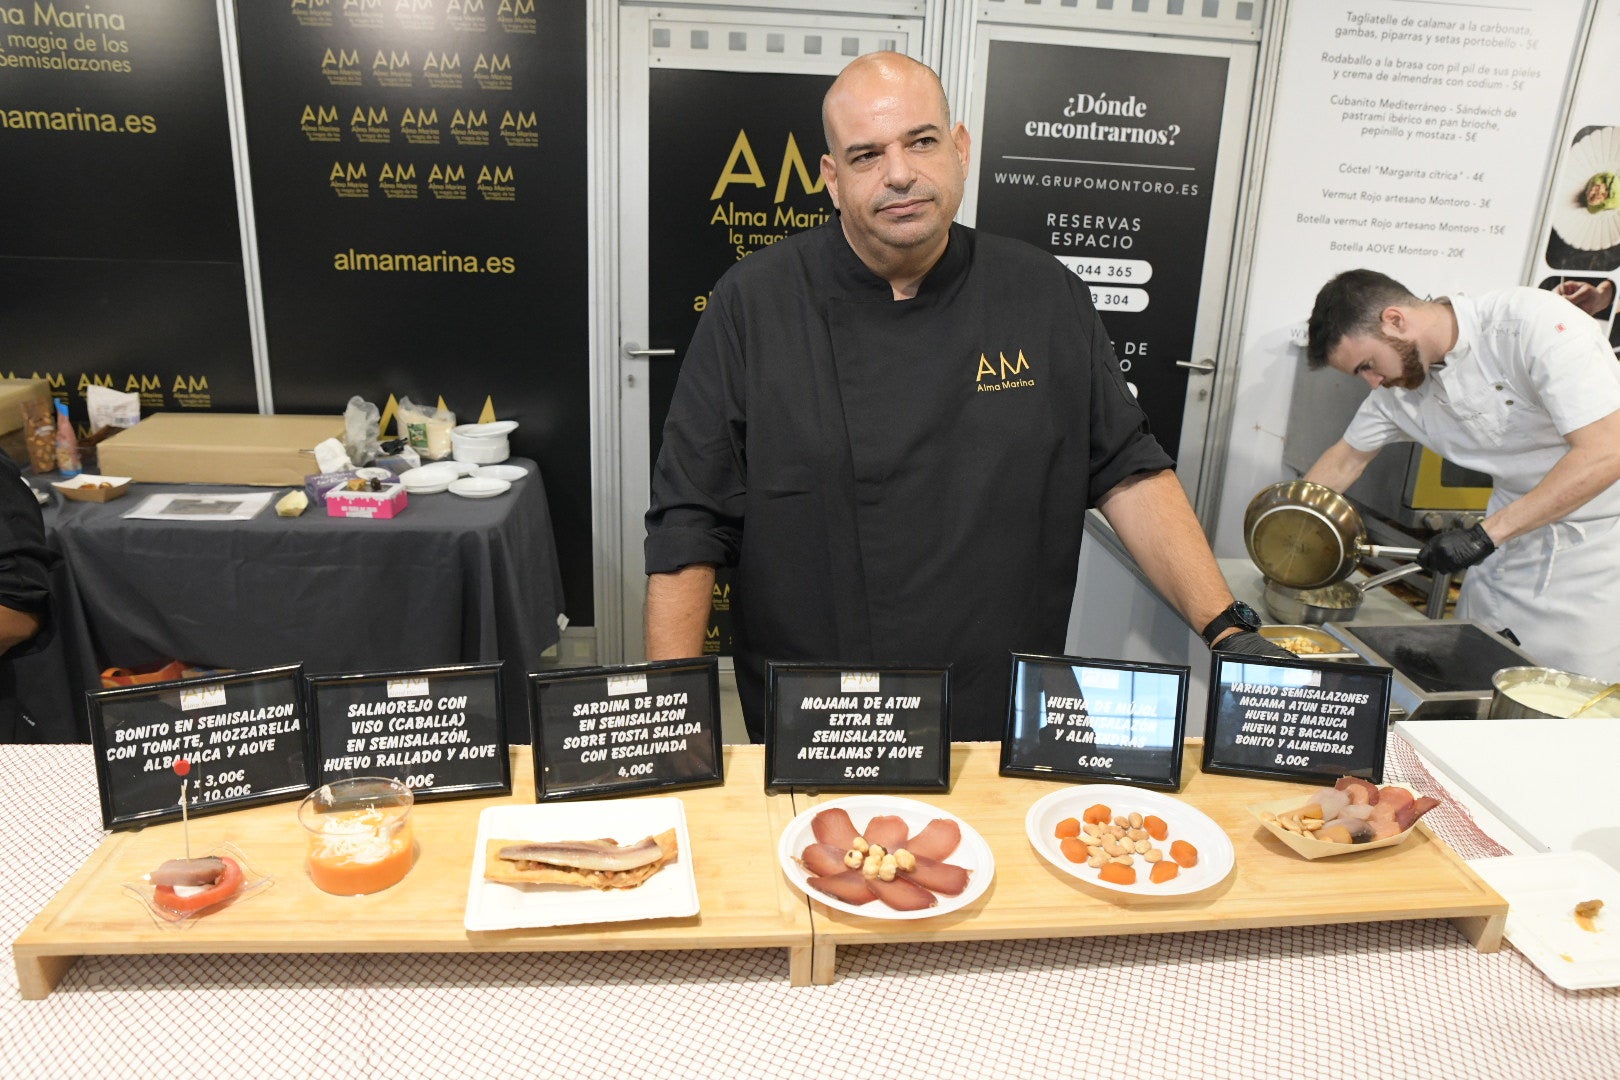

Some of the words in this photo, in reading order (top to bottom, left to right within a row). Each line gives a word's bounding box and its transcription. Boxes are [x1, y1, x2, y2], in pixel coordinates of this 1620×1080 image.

[33, 0, 125, 31] Marina
[1346, 11, 1398, 26] Tagliatelle
[1401, 17, 1415, 27] de
[1417, 18, 1456, 30] calamar
[7, 31, 68, 54] magia
[73, 32, 97, 52] de
[102, 32, 129, 53] los
[1334, 26, 1378, 39] gambas,
[1381, 30, 1423, 42] piparras
[1434, 33, 1461, 45] setas
[1463, 36, 1517, 49] portobello
[0, 48, 132, 73] Semisalazones
[321, 48, 360, 69] AM
[372, 49, 411, 70] AM
[423, 51, 461, 72] AM
[473, 52, 512, 73] AM
[1321, 52, 1372, 67] Rodaballo
[1396, 59, 1424, 71] brasa
[1426, 61, 1445, 72] con
[1446, 62, 1460, 74] pil
[1462, 63, 1476, 76] pil
[1478, 63, 1490, 75] de
[1493, 67, 1510, 77] sus
[1511, 67, 1542, 80] pieles
[1342, 69, 1373, 82] crema
[1376, 71, 1389, 82] de
[1392, 72, 1443, 86] almendras
[1445, 77, 1464, 88] con
[1466, 77, 1503, 90] codium
[300, 104, 338, 126] AM
[1063, 92, 1147, 118] ¿Dónde
[1330, 94, 1376, 108] Cubanito
[1379, 99, 1447, 114] Mediterráneo
[1455, 104, 1502, 118] Sándwich
[1504, 108, 1518, 118] de
[351, 106, 389, 127] AM
[400, 106, 439, 128] AM
[450, 108, 488, 129] AM
[499, 109, 537, 131] AM
[1341, 110, 1386, 123] pastrami
[1388, 112, 1423, 126] ibérico
[1425, 117, 1438, 126] en
[1439, 118, 1459, 129] pan
[1461, 119, 1500, 132] brioche,
[1025, 120, 1181, 146] encontrarnos?
[1361, 126, 1405, 138] pepinillo
[1415, 130, 1456, 142] mostaza
[1465, 131, 1477, 143] 5€
[329, 161, 367, 182] AM
[378, 162, 416, 183] AM
[427, 163, 465, 184] AM
[477, 164, 514, 184] AM
[1338, 162, 1371, 175] Cóctel
[1472, 172, 1485, 183] 4€
[994, 172, 1199, 196] WWW.GRUPOMONTORO.ES
[1322, 188, 1358, 201] Vermut
[1360, 191, 1382, 203] Rojo
[1384, 194, 1427, 205] artesano
[1428, 196, 1471, 208] Montoro
[1477, 199, 1492, 209] 3€
[710, 202, 767, 226] Alma
[1046, 213, 1142, 232] RESERVAS
[1296, 213, 1331, 225] Botella
[1333, 217, 1368, 227] vermut
[1370, 217, 1393, 230] Rojo
[1395, 220, 1436, 231] artesano
[1438, 222, 1480, 234] Montoro
[1489, 225, 1506, 236] 15€
[729, 228, 744, 245] la
[1051, 231, 1134, 250] ESPACIO
[1329, 241, 1363, 253] Botella
[1366, 243, 1395, 255] AOVE
[1397, 245, 1439, 257] Montoro
[1447, 247, 1465, 258] 20€
[333, 248, 516, 274] almamarina.es
[1076, 264, 1101, 275] 044
[1107, 266, 1132, 277] 365
[1105, 294, 1129, 305] 304
[1125, 342, 1148, 355] DE
[976, 348, 1030, 382] AM
[125, 373, 161, 393] AM
[172, 374, 209, 393] AM
[977, 384, 1001, 392] Alma
[1001, 378, 1035, 389] Marina
[800, 696, 858, 710] MOJAMA
[863, 697, 882, 709] DE
[885, 696, 921, 709] ATUN
[1047, 696, 1088, 711] HUEVA
[1230, 682, 1279, 696] VARIADO
[1280, 686, 1369, 705] SEMISALAZONES
[347, 699, 433, 718] SALMOREJO
[437, 696, 468, 710] CON
[572, 698, 630, 717] SARDINA
[634, 696, 653, 710] DE
[655, 692, 688, 707] BOTA
[1239, 696, 1285, 710] MOJAMA
[1288, 701, 1318, 713] ATUN
[1321, 703, 1356, 716] EXTRA
[115, 723, 170, 743] BONITO
[174, 719, 193, 734] EN
[197, 703, 294, 730] SEMISALAZON
[351, 719, 384, 735] VISO
[388, 712, 466, 733] (CABALLA)
[578, 718, 596, 732] EN
[598, 709, 686, 730] SEMISALAZON
[829, 713, 871, 726] EXTRA
[876, 713, 894, 725] EN
[1047, 712, 1065, 725] EN
[1244, 709, 1280, 722] HUEVA
[1283, 712, 1298, 723] DE
[1300, 717, 1348, 729] MARUCA
[106, 745, 137, 762] CON
[142, 734, 204, 756] TOMATE,
[209, 718, 301, 745] MOZZARELLA
[346, 738, 366, 753] EN
[369, 728, 471, 751] SEMISALAZÓN,
[563, 733, 607, 750] SOBRE
[610, 727, 649, 744] TOSTA
[652, 721, 702, 739] SALADA
[812, 730, 907, 744] SEMISALAZON,
[1242, 722, 1277, 735] HUEVA
[1280, 726, 1296, 737] DE
[1299, 728, 1349, 742] BACALAO
[239, 739, 276, 755] AOVE
[580, 749, 608, 764] CON
[611, 739, 688, 760] ESCALIVADA
[797, 746, 872, 760] AVELLANAS
[888, 746, 924, 759] AOVE
[1235, 734, 1274, 748] BONITO
[1286, 739, 1355, 755] ALMENDRAS
[323, 756, 371, 772] HUEVO
[375, 750, 442, 768] RALLADO
[459, 744, 497, 761] AOVE
[1078, 755, 1114, 769] 6,00€
[1274, 753, 1310, 767] 8,00€
[205, 769, 245, 787] 3,00€
[617, 762, 654, 778] 4,00€
[844, 766, 880, 779] 5,00€
[203, 784, 251, 802] 10.00€
